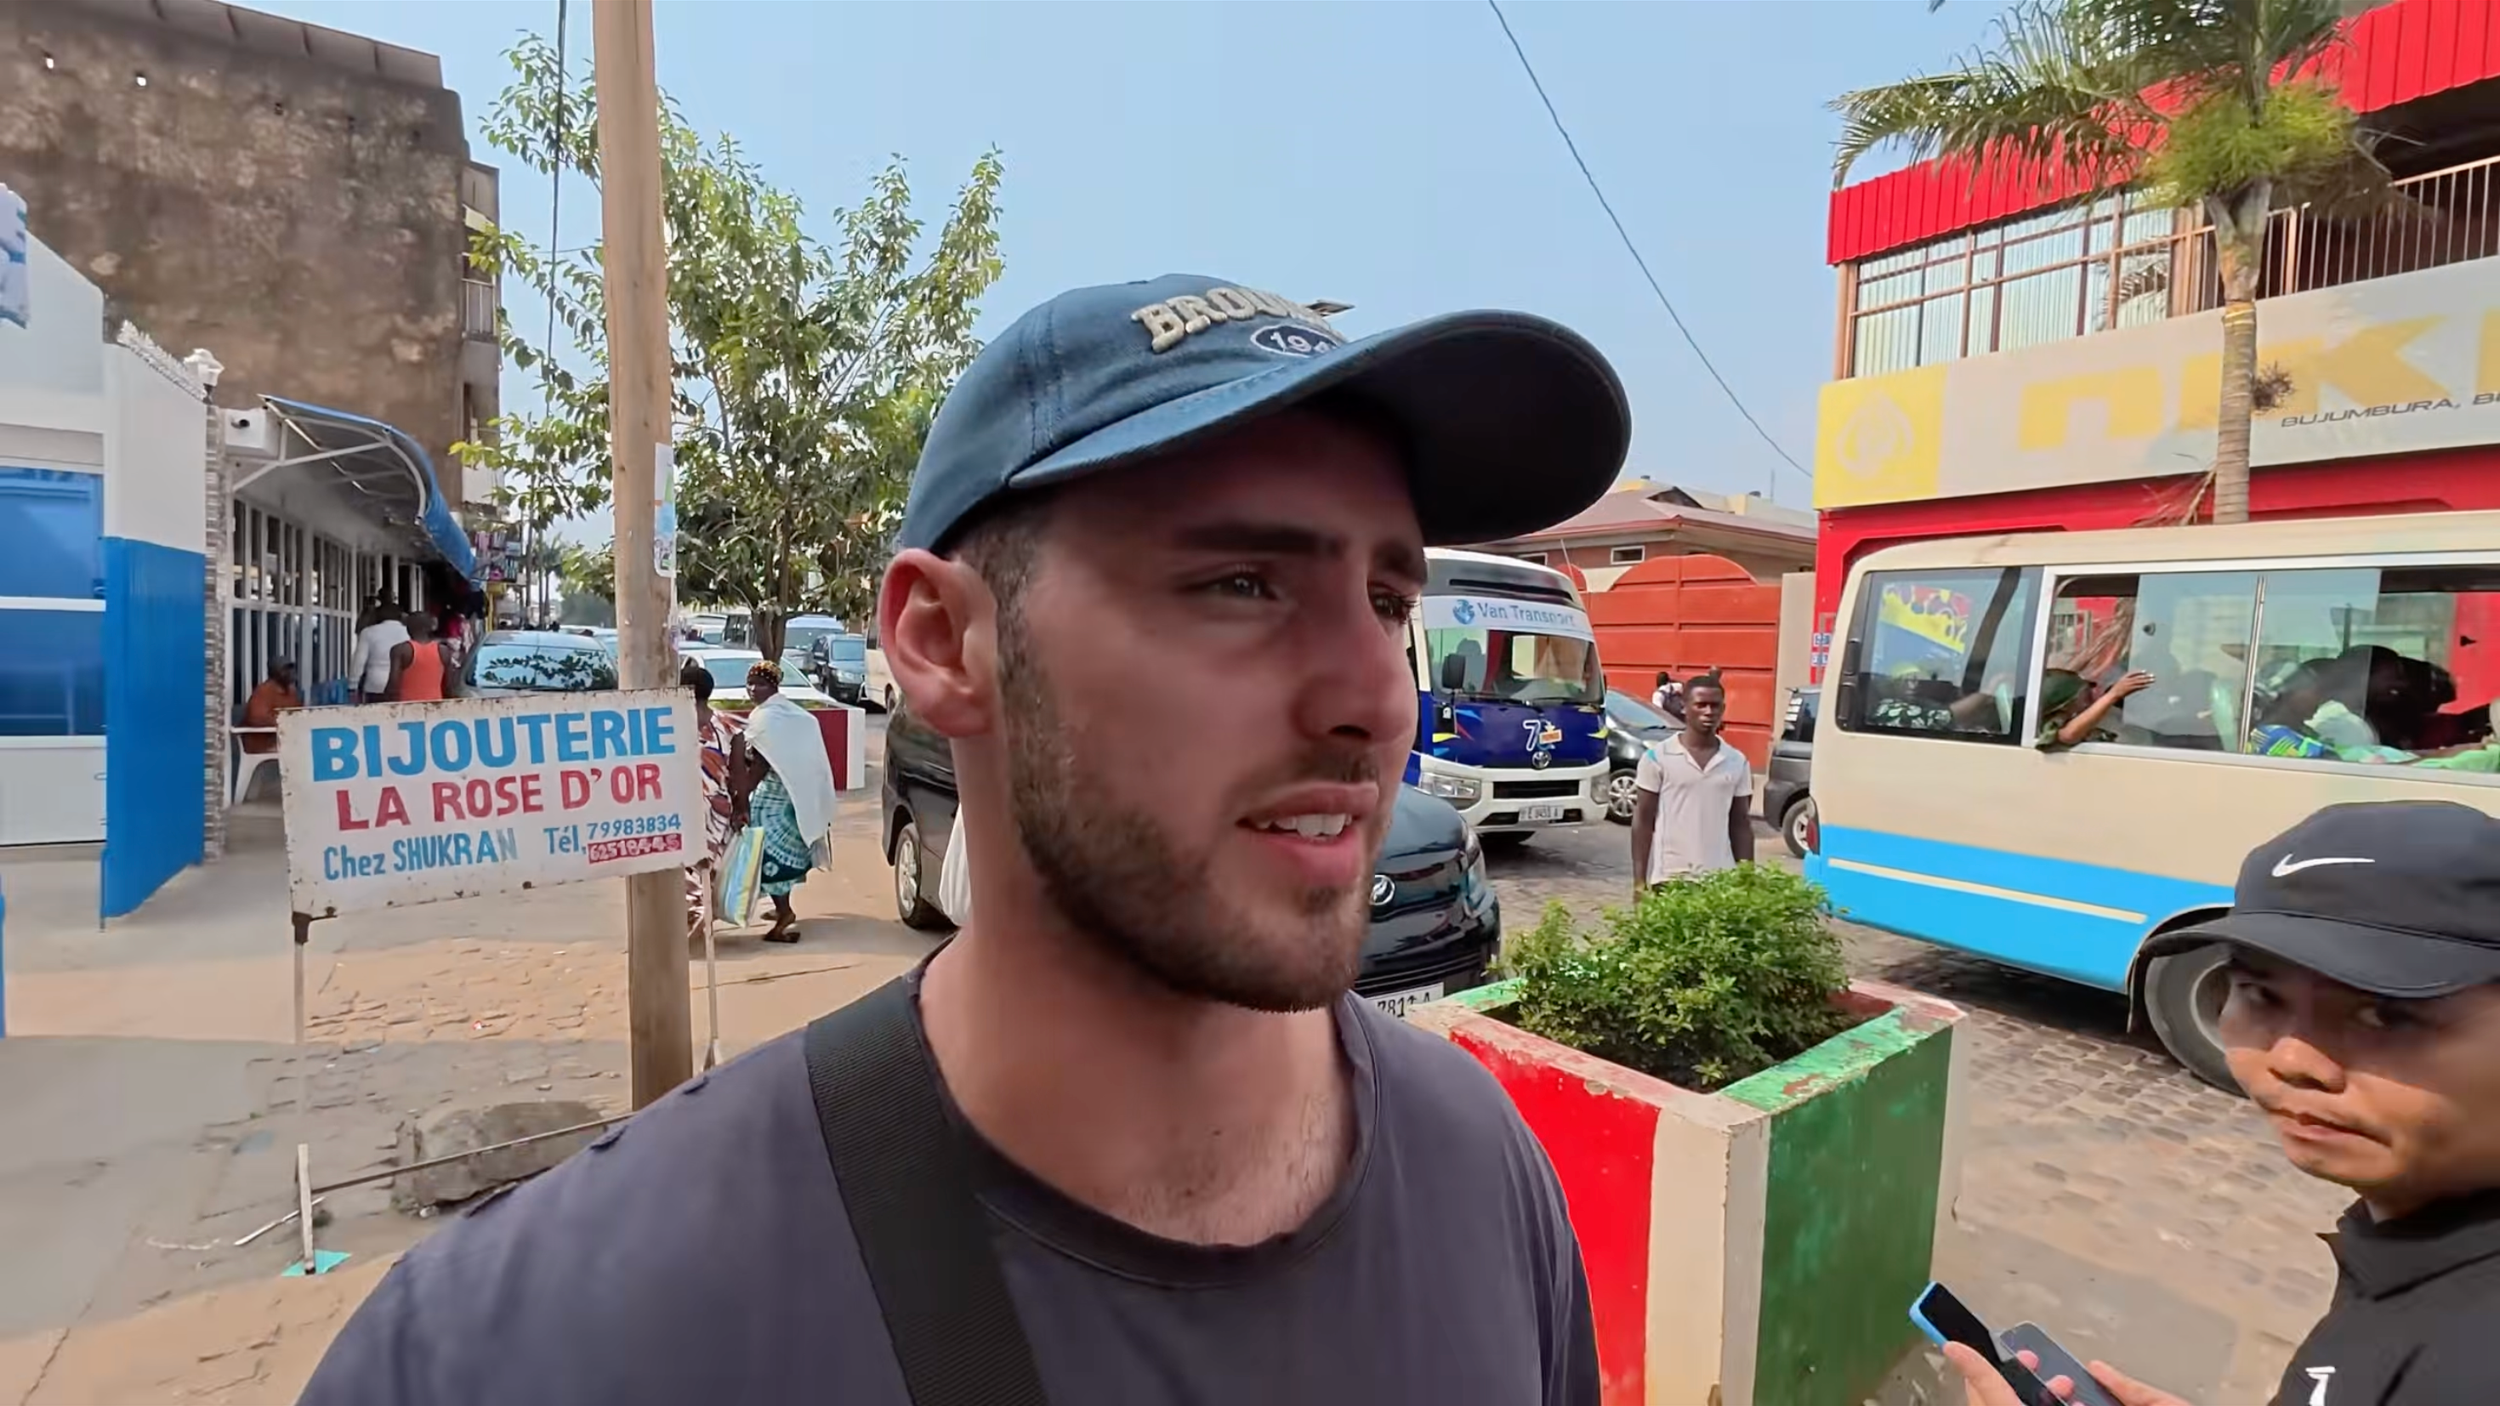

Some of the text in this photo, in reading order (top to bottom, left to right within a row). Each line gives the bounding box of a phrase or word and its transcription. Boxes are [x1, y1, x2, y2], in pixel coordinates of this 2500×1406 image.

[2281, 392, 2500, 427] BUJUMBURA, B
[1477, 602, 1508, 619] Van
[311, 707, 676, 782] BIJOUTERIE
[336, 763, 662, 831] LA ROSE D'OR
[324, 845, 386, 881] Chez
[393, 828, 518, 872] SHUKRAN
[587, 813, 681, 840] 79983834
